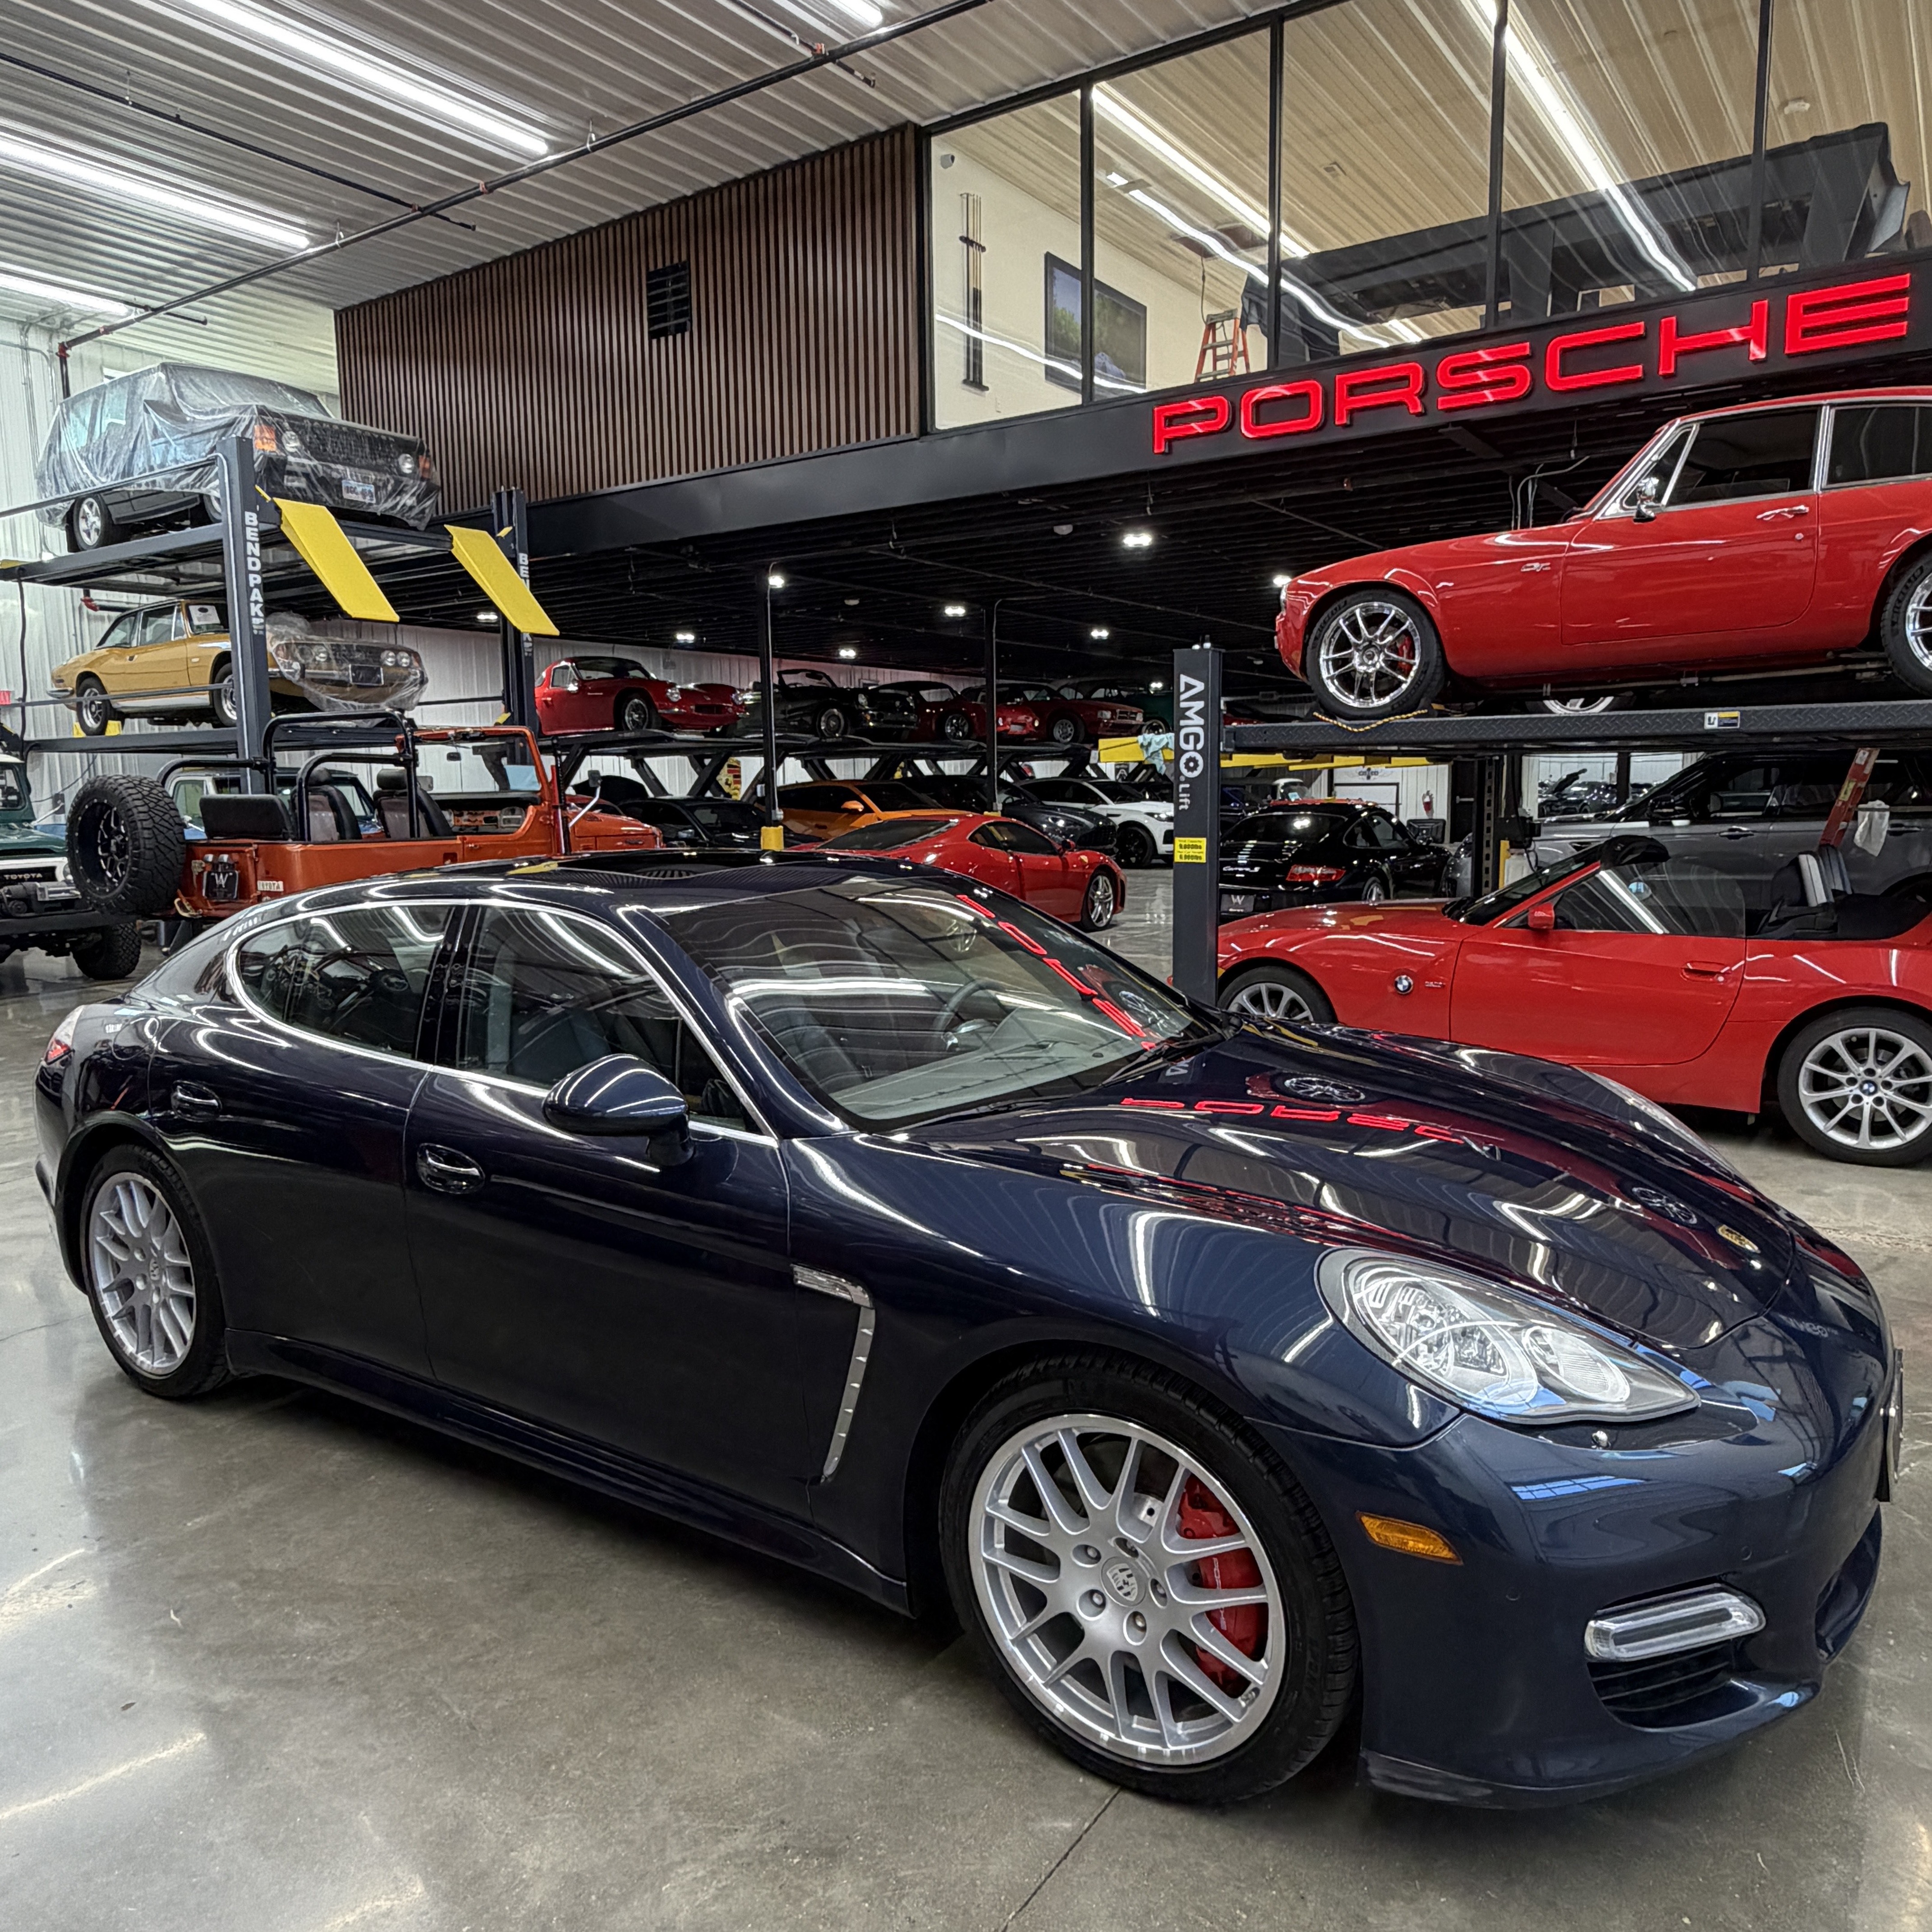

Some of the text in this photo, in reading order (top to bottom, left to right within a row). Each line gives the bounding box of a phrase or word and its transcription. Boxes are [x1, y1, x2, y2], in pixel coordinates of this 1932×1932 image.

[1152, 272, 1911, 455] PORSCHE
[244, 511, 264, 617] BENDPAK
[1178, 674, 1205, 810] AMGO Lift
